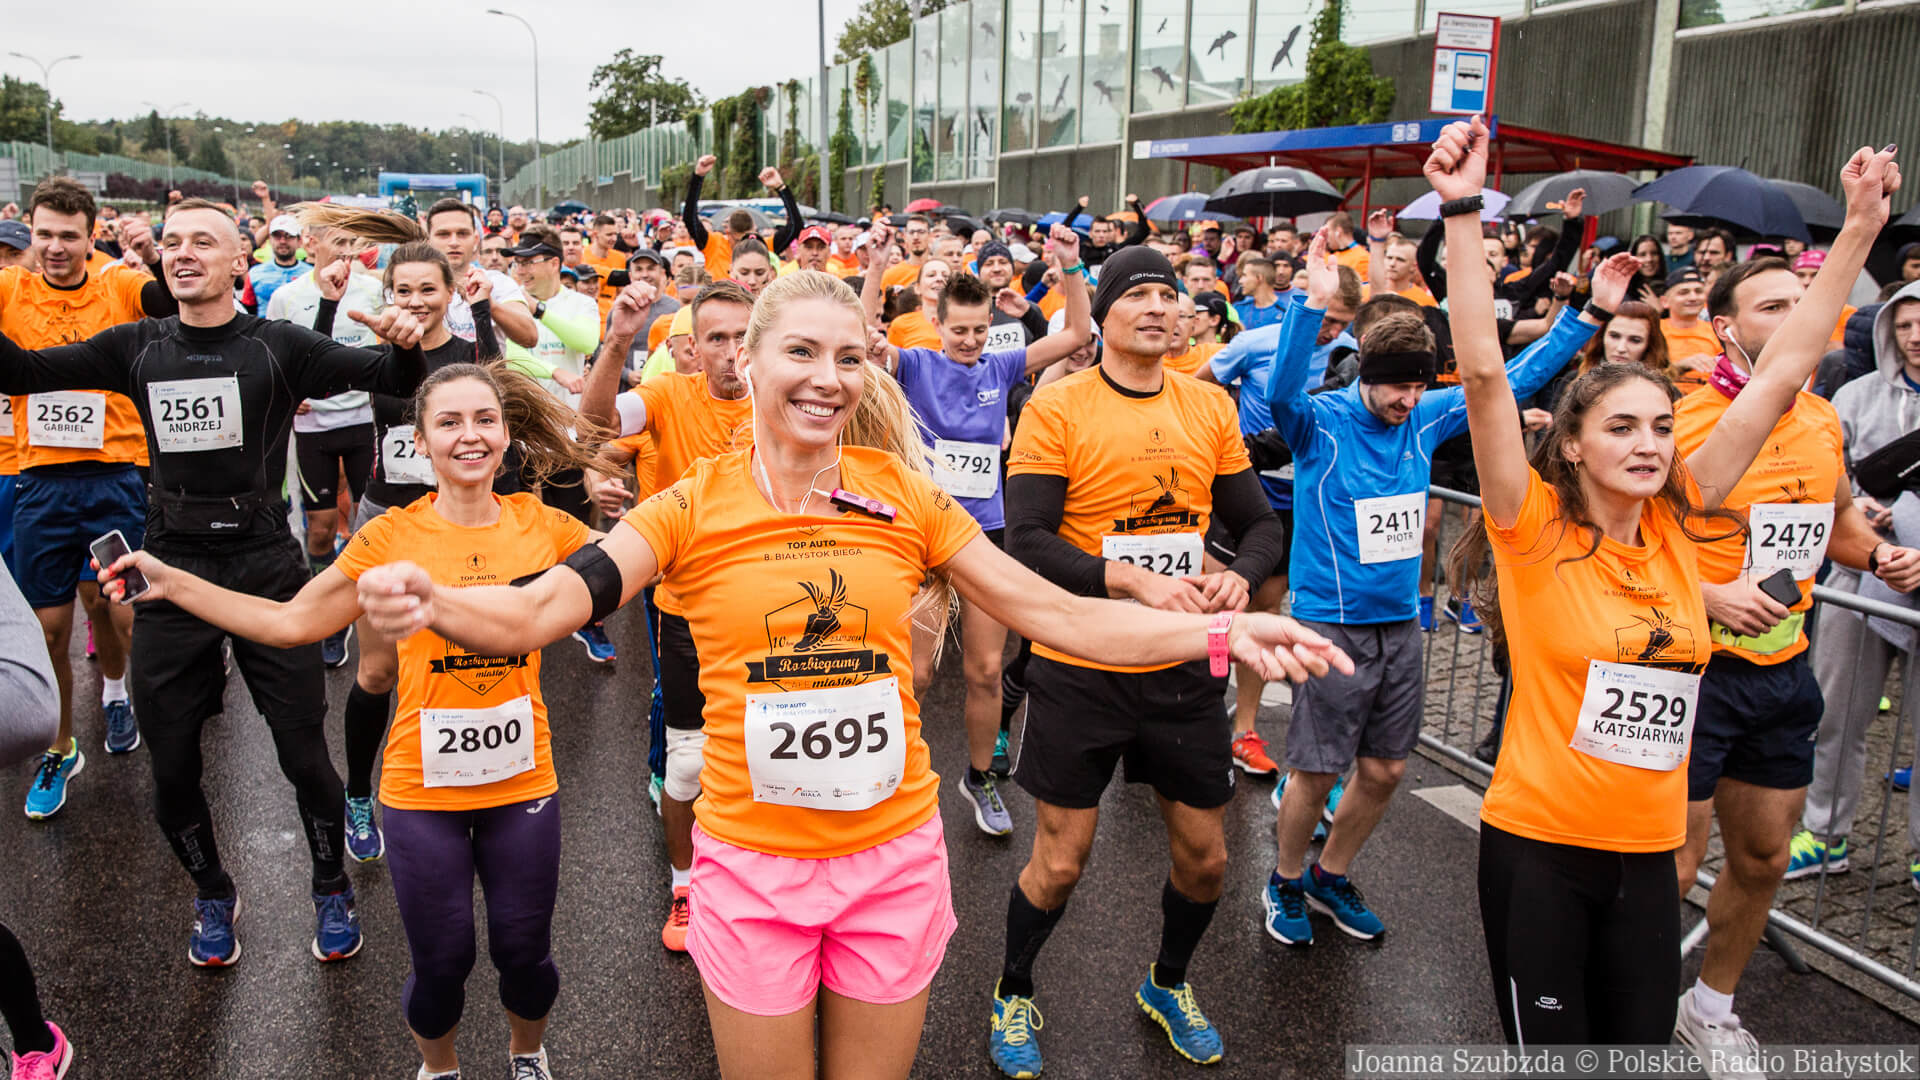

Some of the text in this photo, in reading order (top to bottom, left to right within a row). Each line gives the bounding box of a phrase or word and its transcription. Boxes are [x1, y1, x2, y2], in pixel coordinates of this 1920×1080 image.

[37, 404, 94, 424] 2562
[159, 395, 224, 422] 2561
[44, 423, 86, 433] GABRIEL
[169, 420, 222, 433] ANDRZEJ
[1369, 508, 1420, 535] 2411
[1386, 531, 1414, 544] PIOTR
[1760, 522, 1825, 548] 2479
[786, 539, 837, 550] TOP AUTO
[775, 550, 830, 560] BIAŁYSTOK
[833, 548, 863, 556] BIEGA
[1776, 549, 1810, 560] PIOTR
[772, 636, 786, 649] 10
[778, 656, 860, 674] Rozbiegamy
[812, 674, 858, 689] miasto!
[1600, 687, 1687, 728] 2529
[438, 718, 521, 755] 2800
[769, 711, 889, 760] 2695
[1593, 719, 1684, 745] KATSIARYNA
